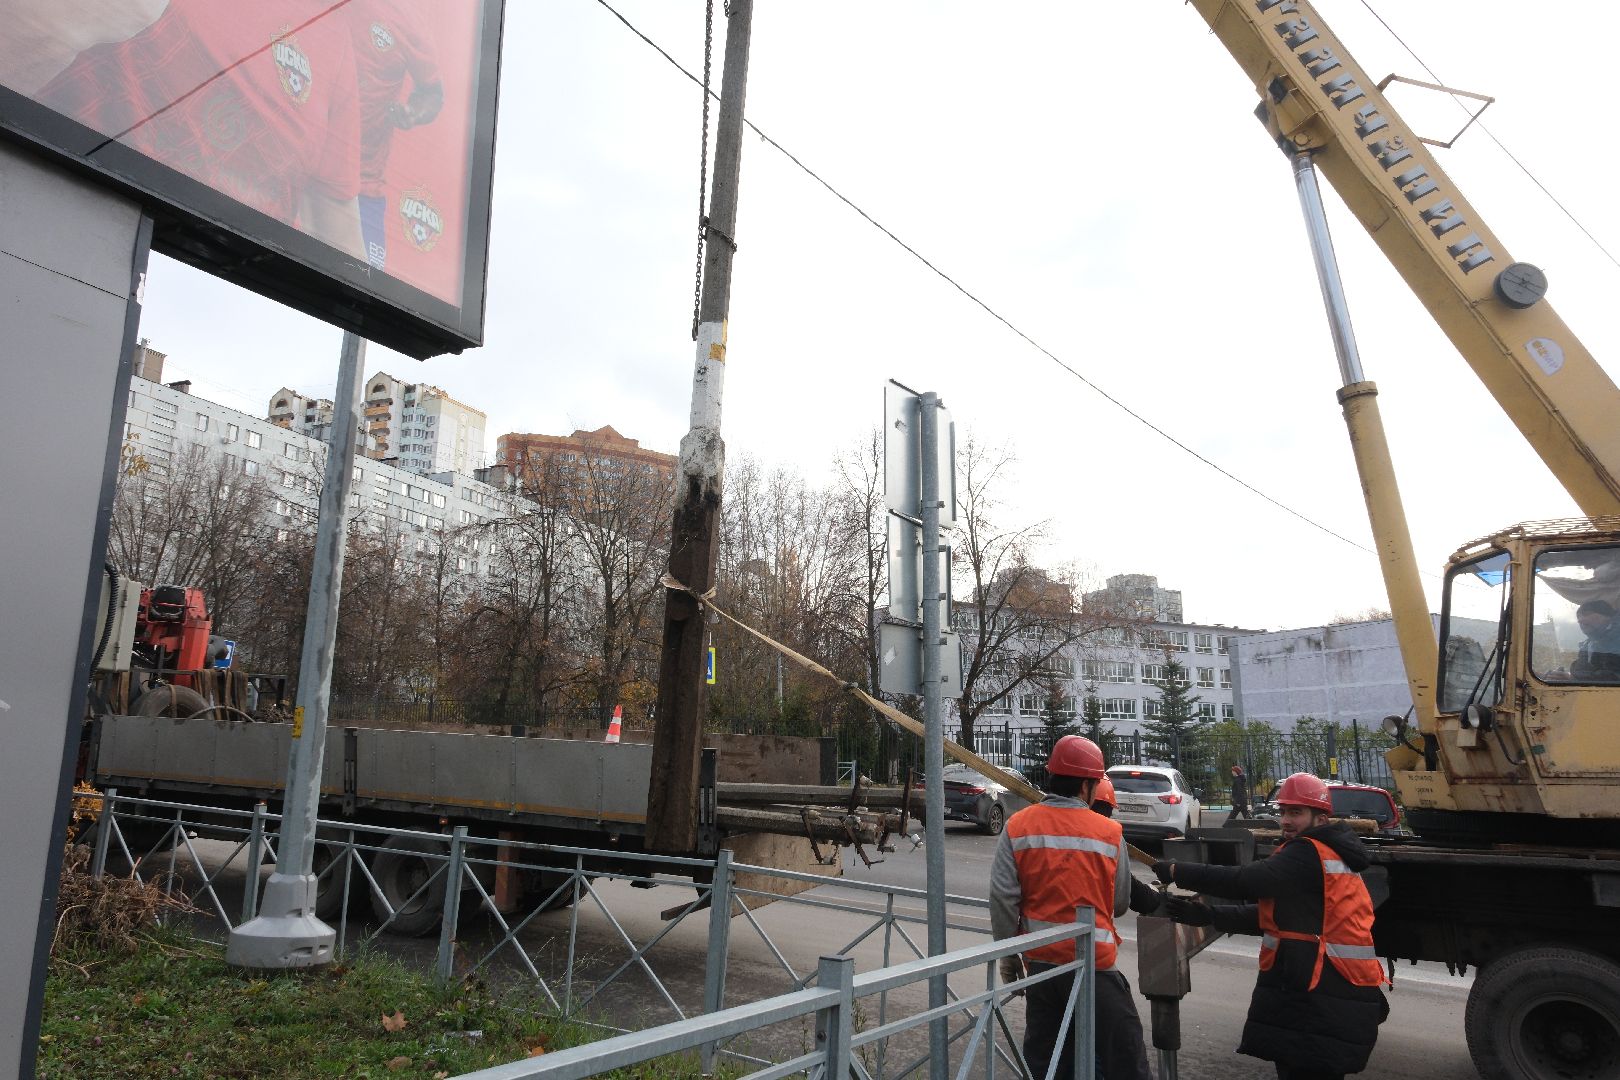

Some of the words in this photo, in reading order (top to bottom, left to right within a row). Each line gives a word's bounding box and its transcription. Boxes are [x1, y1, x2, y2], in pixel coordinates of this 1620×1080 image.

[372, 24, 393, 46] ЦСКА
[276, 44, 312, 82] ЦСКА
[401, 197, 440, 233] ЦСКА
